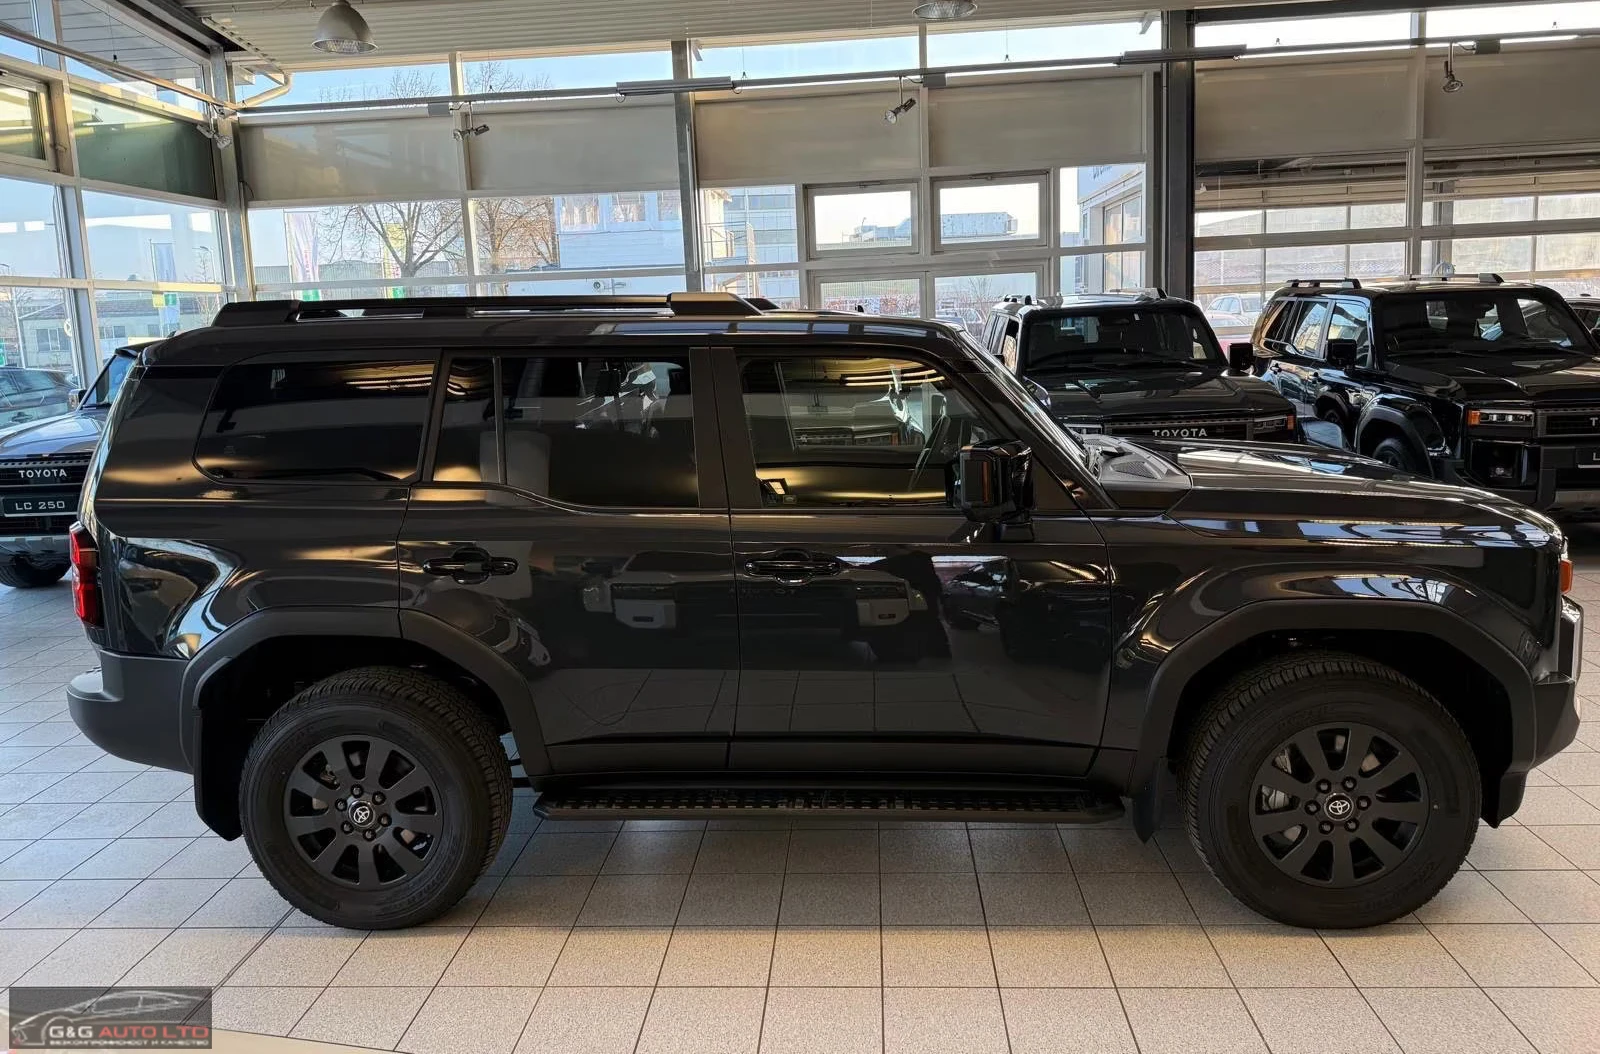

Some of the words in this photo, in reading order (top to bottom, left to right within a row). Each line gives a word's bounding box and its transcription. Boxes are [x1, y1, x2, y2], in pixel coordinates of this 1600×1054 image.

[1152, 428, 1208, 437] TOYOTA
[18, 468, 68, 478] TOYOTA
[15, 502, 33, 511] LC
[38, 500, 66, 510] 250
